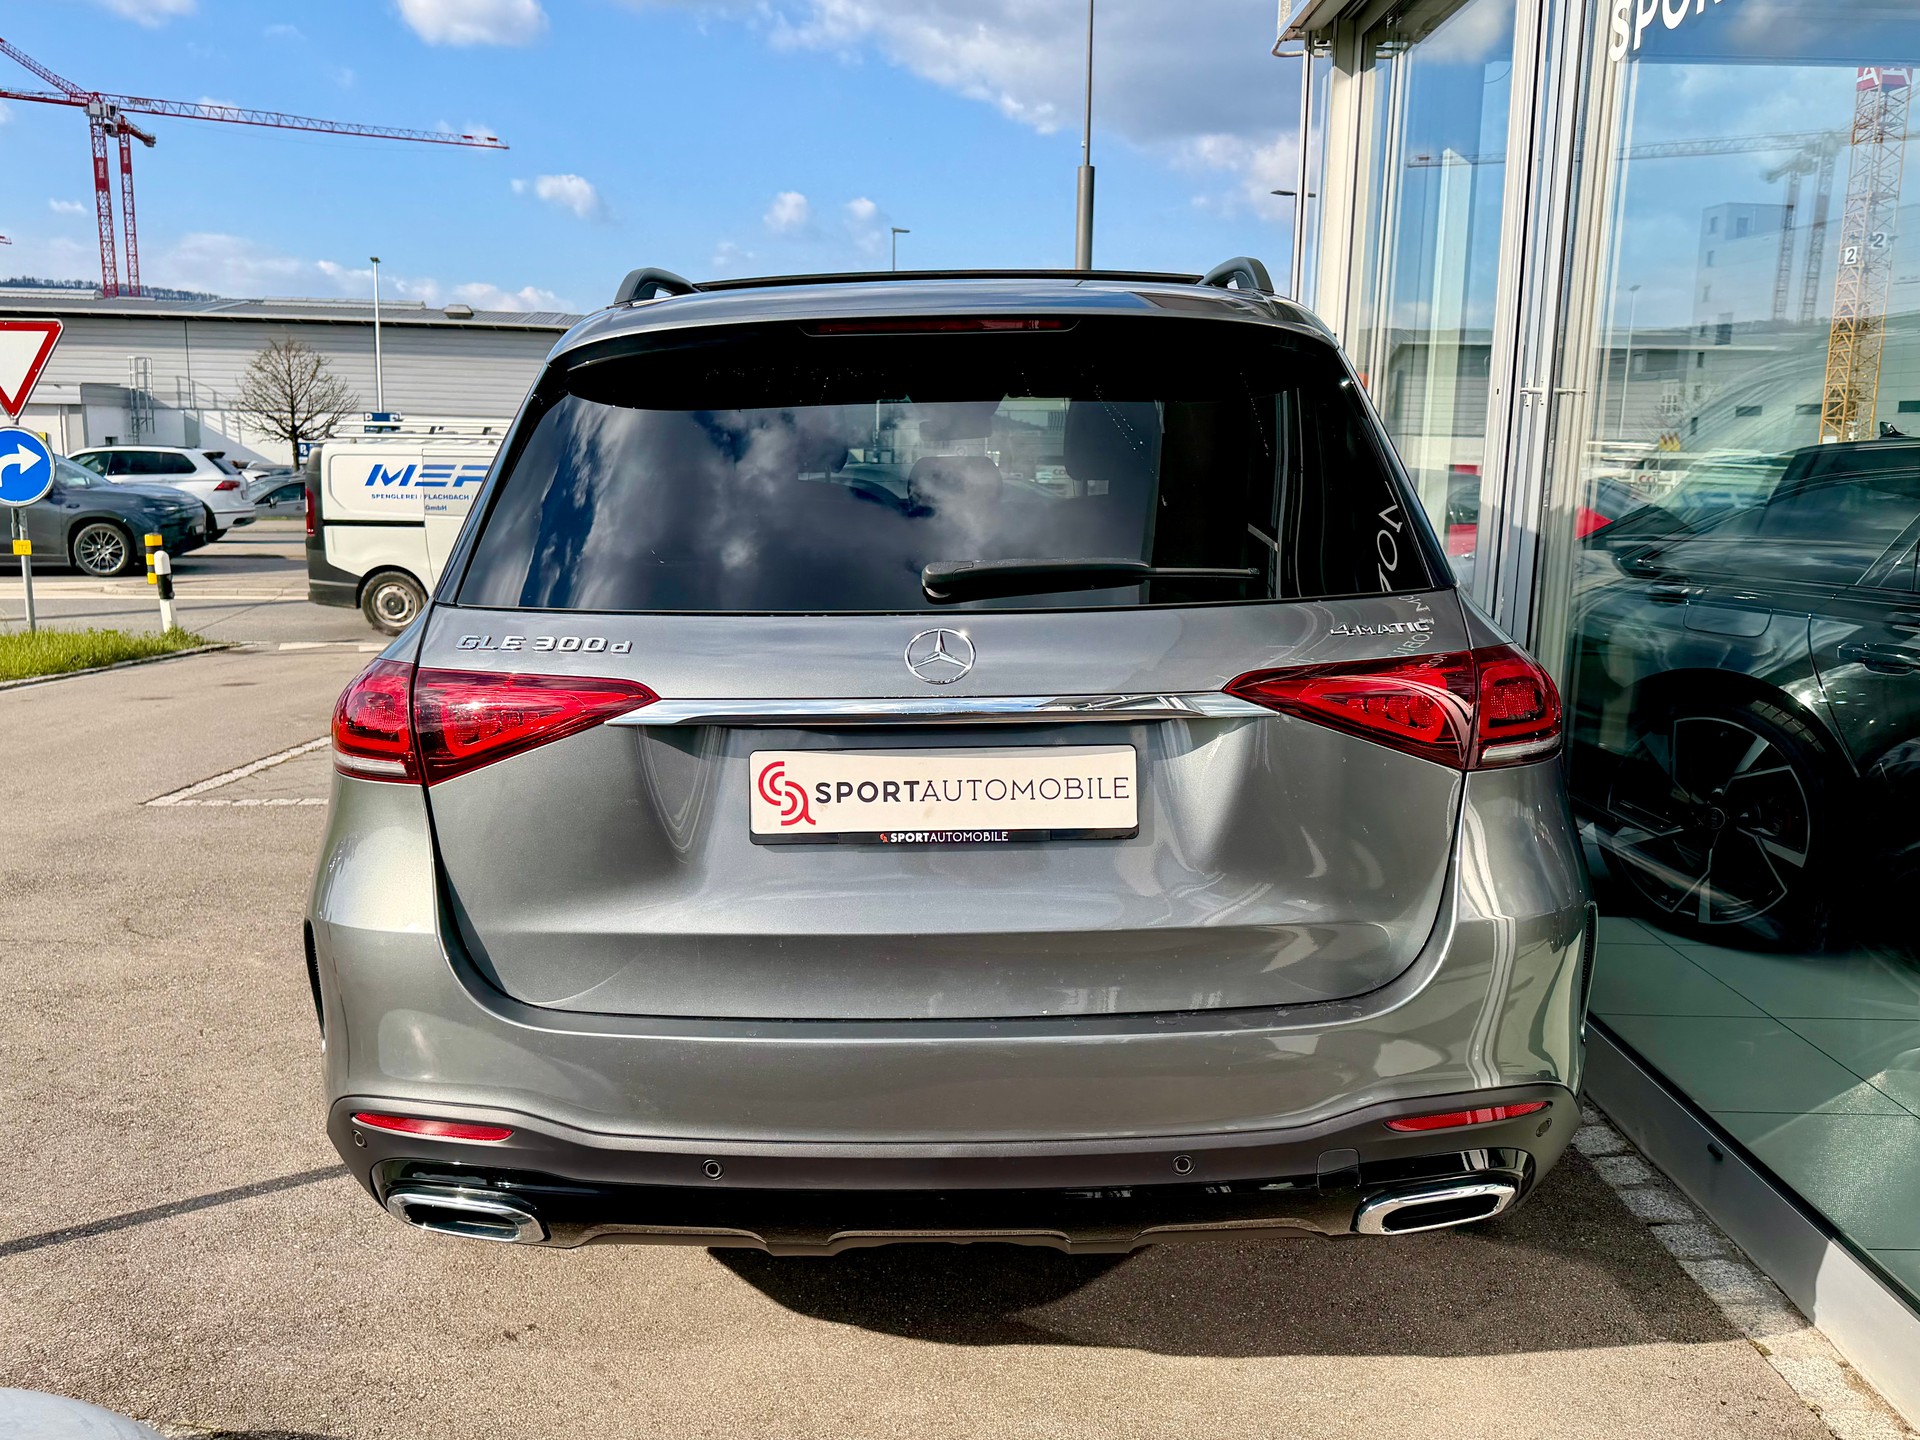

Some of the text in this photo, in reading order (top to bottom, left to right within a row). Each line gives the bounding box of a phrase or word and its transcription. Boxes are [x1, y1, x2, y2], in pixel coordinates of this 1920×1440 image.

[424, 493, 470, 501] FLACHDACH
[456, 635, 526, 651] GLE
[815, 776, 1130, 804] SPORTAUTOMOBILE
[890, 831, 1009, 843] SPORTAUTOMOBILE
